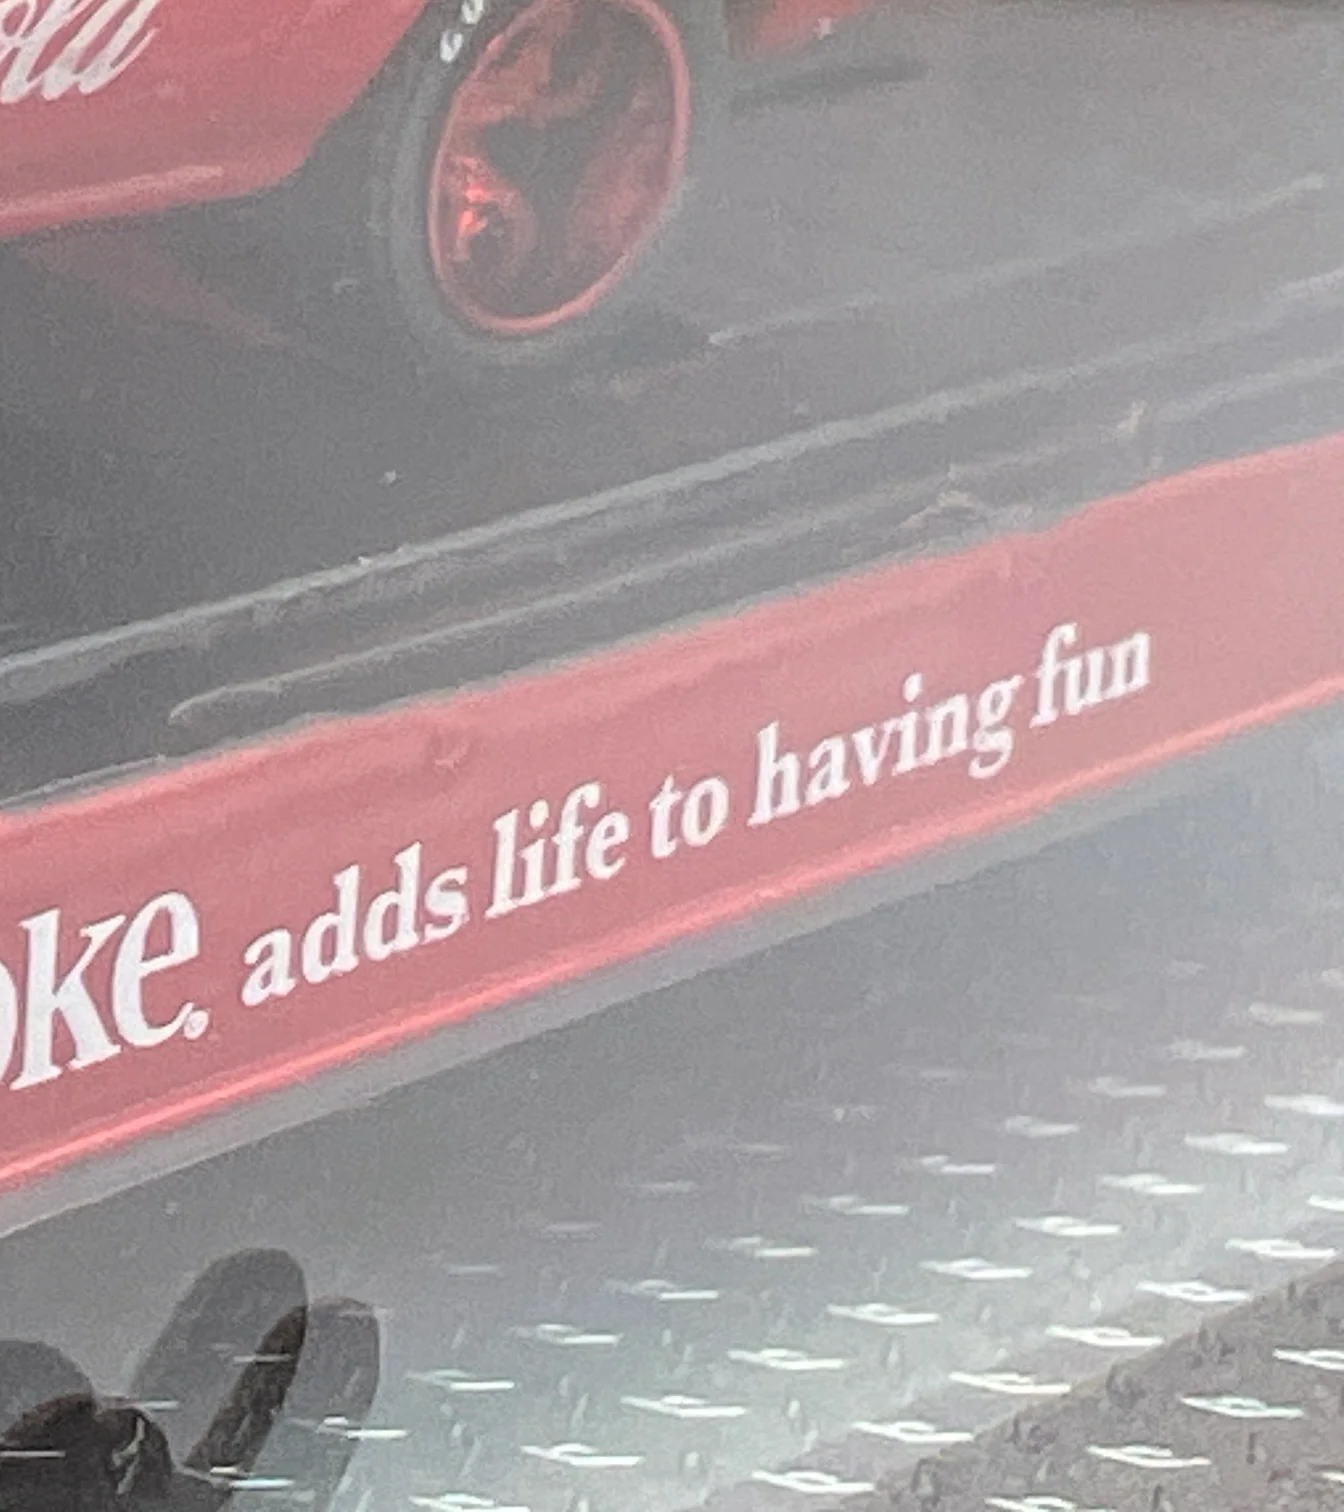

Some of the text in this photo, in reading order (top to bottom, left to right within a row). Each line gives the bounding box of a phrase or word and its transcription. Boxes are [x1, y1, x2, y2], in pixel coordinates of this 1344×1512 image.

[242, 842, 469, 1007] adds
[486, 782, 631, 920] life
[648, 771, 730, 861] to
[745, 672, 1023, 828] having
[1028, 621, 1152, 731] fun
